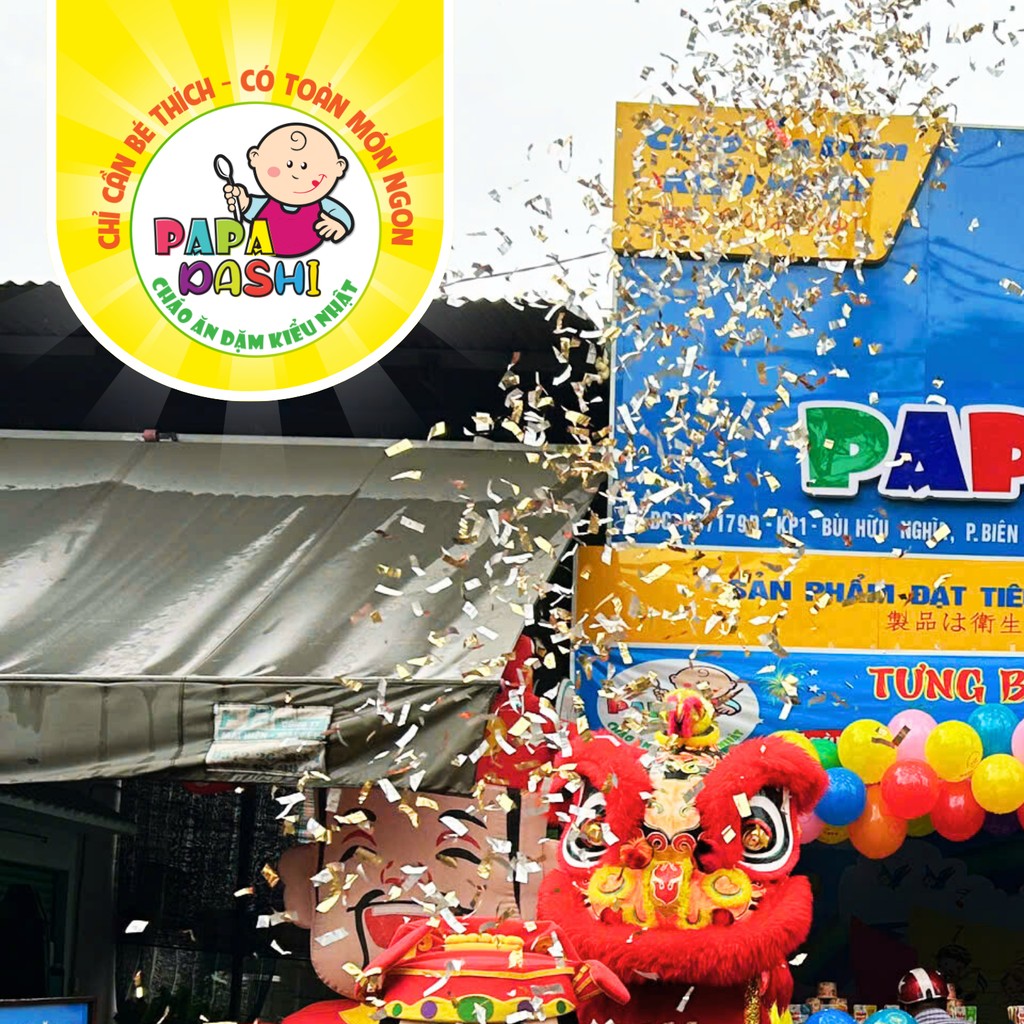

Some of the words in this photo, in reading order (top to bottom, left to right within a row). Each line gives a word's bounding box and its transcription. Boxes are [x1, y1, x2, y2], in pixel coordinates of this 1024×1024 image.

[822, 513, 849, 537] BÙI
[911, 583, 966, 608] ĐẠT
[868, 662, 985, 704] TƯNG
